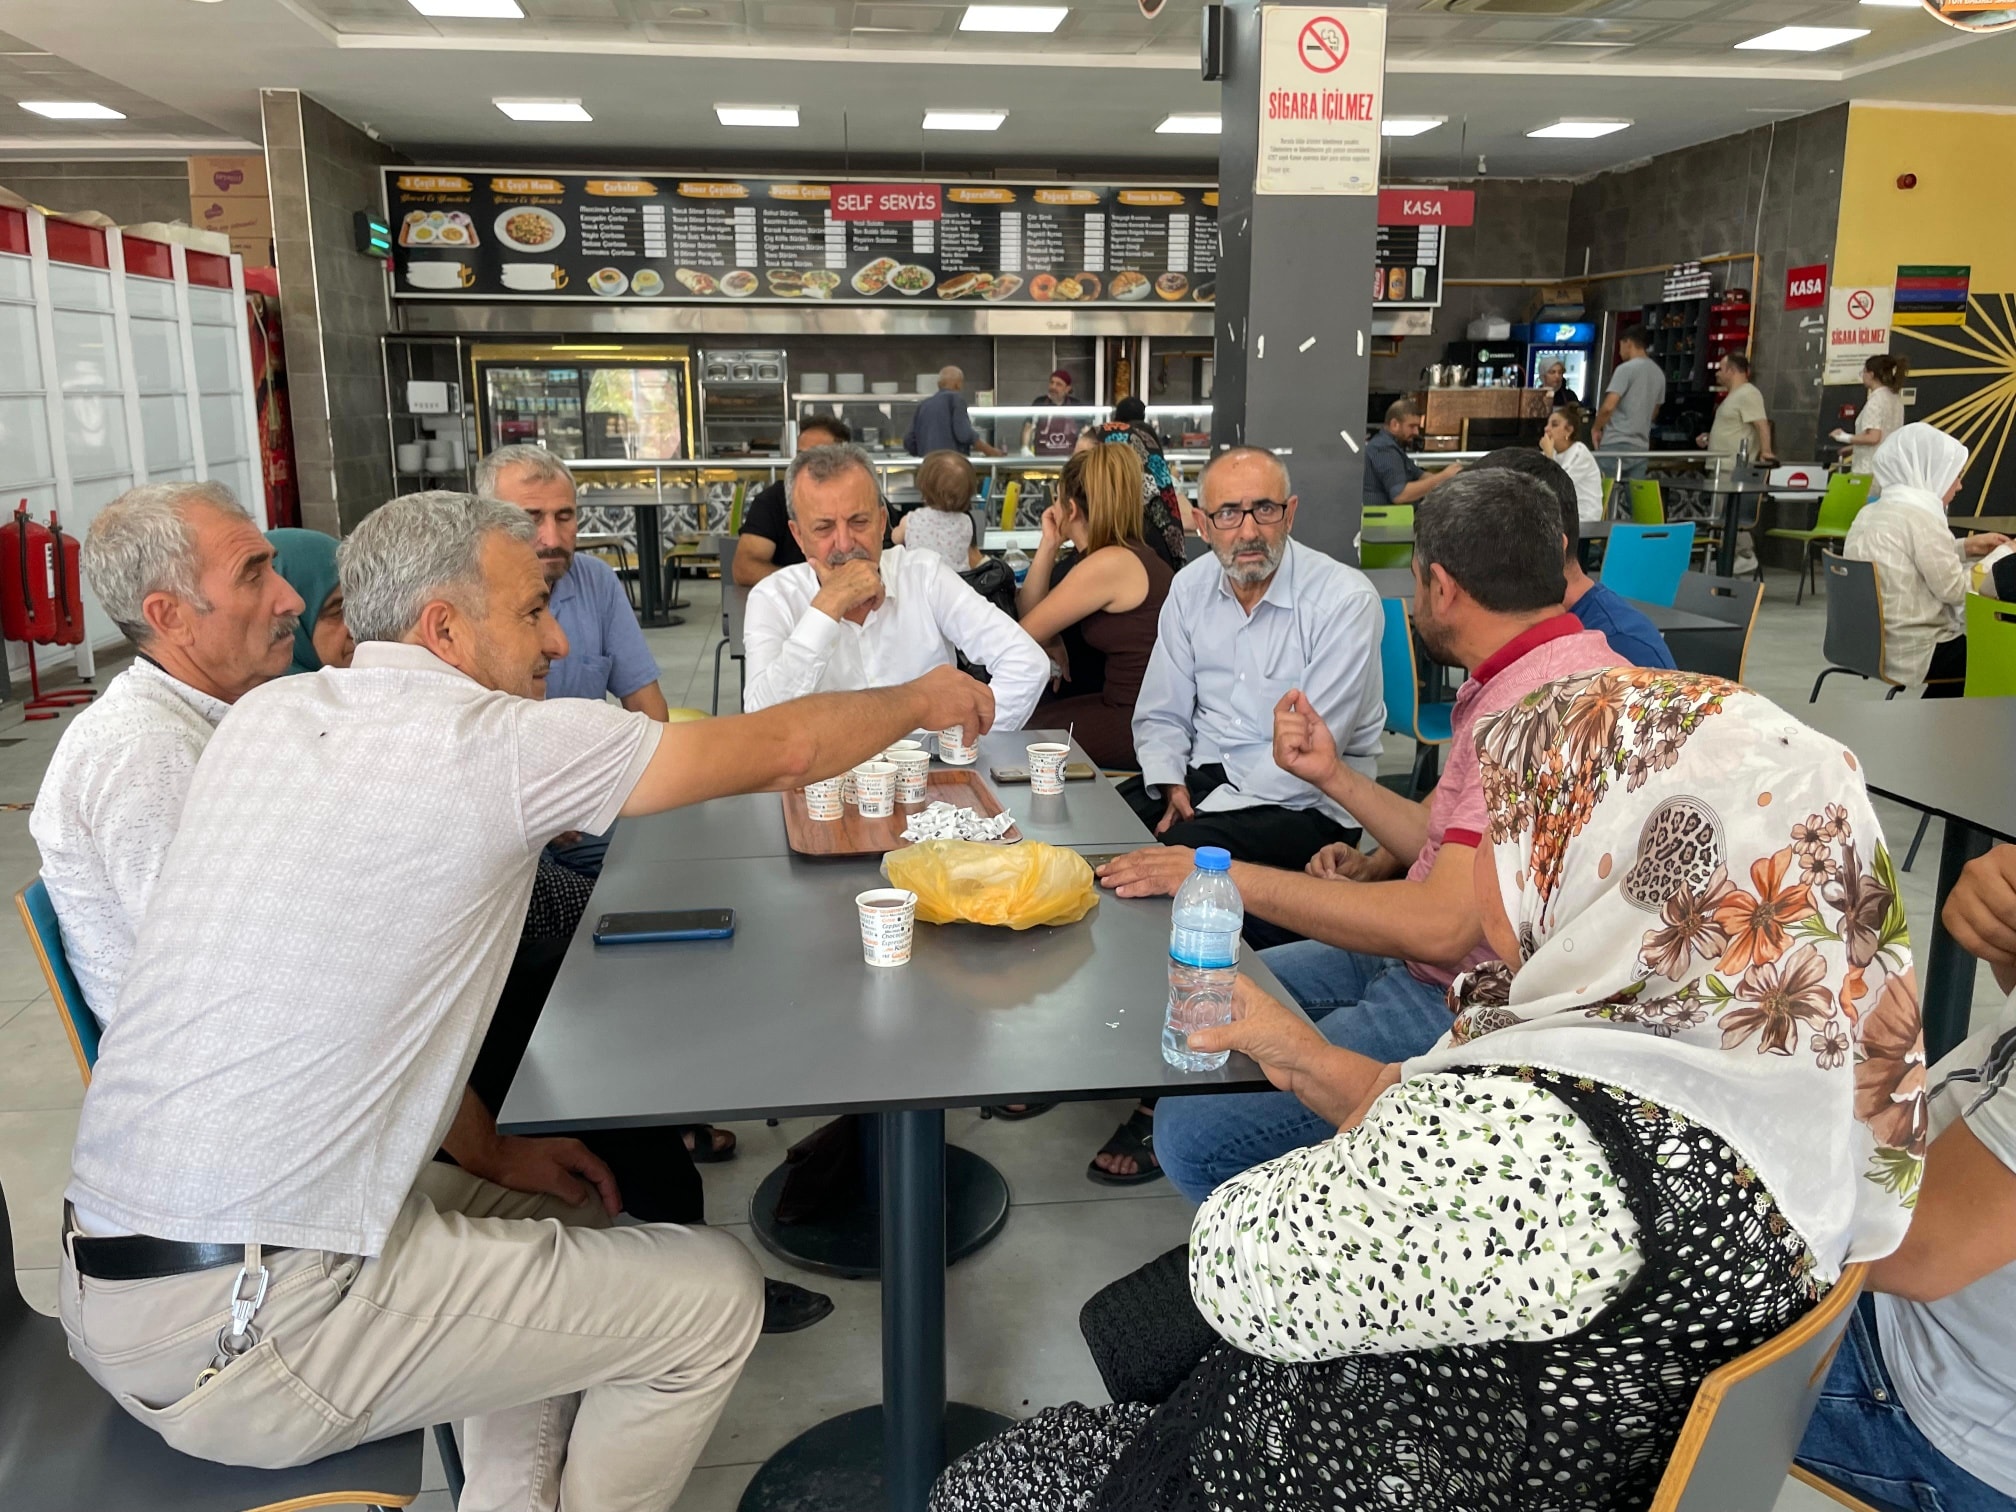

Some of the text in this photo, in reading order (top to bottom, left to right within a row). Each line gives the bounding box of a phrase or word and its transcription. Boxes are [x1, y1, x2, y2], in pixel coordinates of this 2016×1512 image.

[1269, 87, 1374, 124] SİGARA İÇİLMEZ
[838, 192, 936, 210] SELF SERVİS
[1403, 200, 1442, 216] KASA
[1790, 278, 1822, 296] KASA
[1832, 326, 1886, 346] SİGARA İÇİLMEZ
